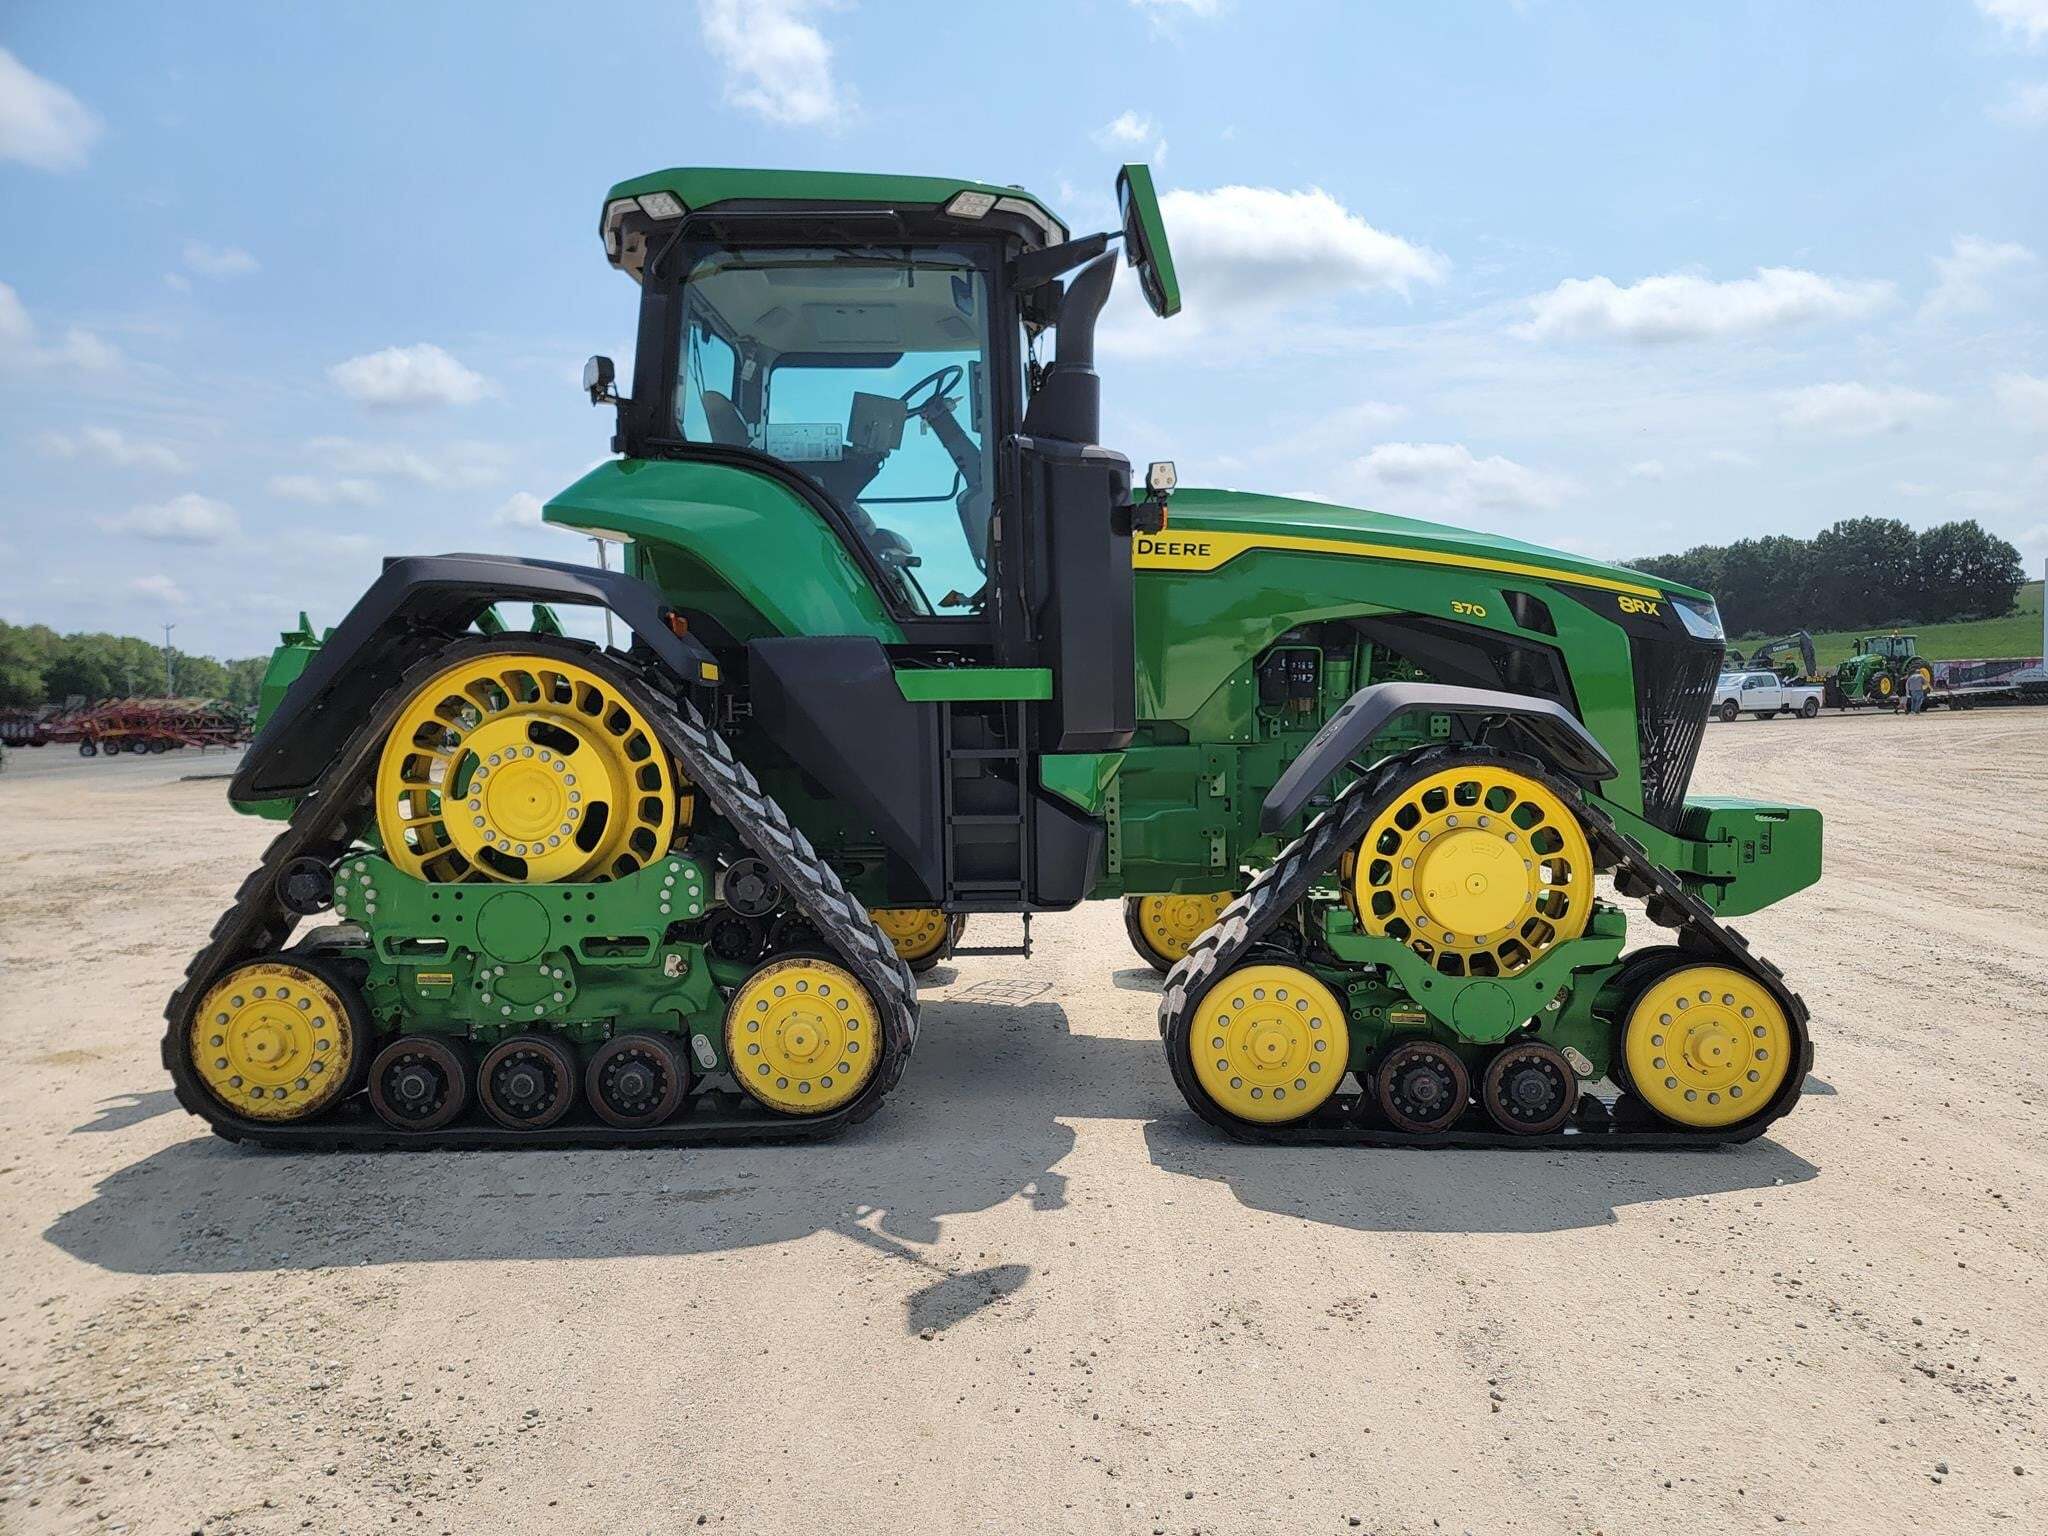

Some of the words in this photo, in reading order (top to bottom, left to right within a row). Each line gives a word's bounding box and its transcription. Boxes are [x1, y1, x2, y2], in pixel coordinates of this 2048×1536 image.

[1138, 539, 1211, 556] DEERE
[1451, 601, 1486, 617] 370
[1617, 595, 1661, 617] 8RX
